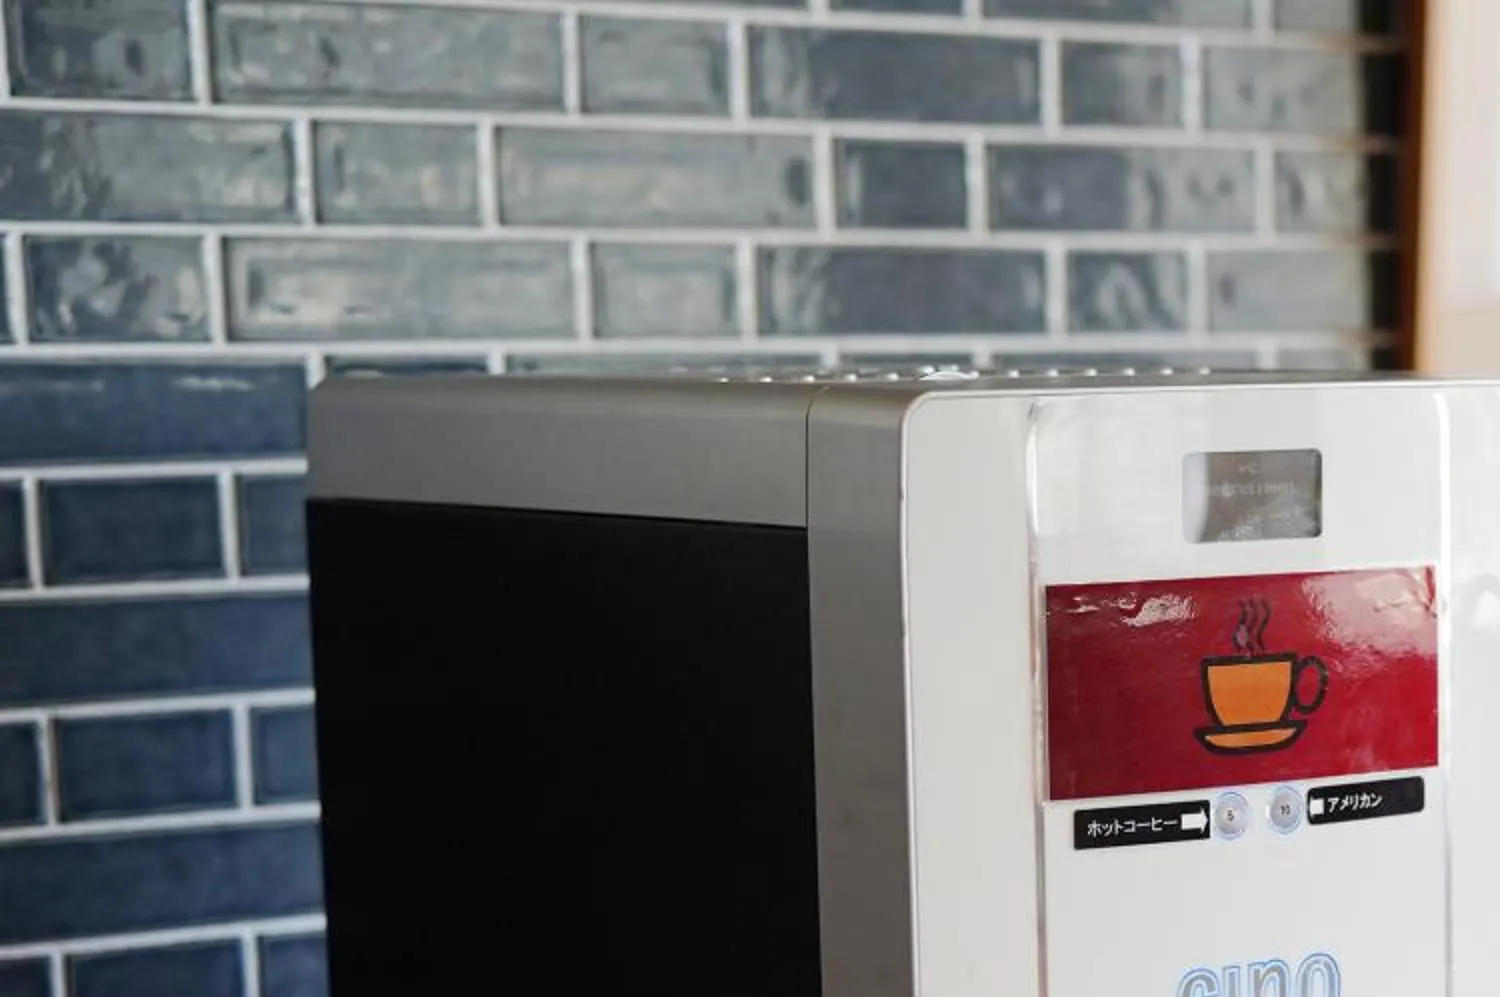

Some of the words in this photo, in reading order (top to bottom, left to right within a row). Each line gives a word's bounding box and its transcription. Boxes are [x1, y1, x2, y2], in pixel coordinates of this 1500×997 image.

[1327, 791, 1384, 814] アメリカン
[1087, 816, 1179, 838] ホットコーヒー
